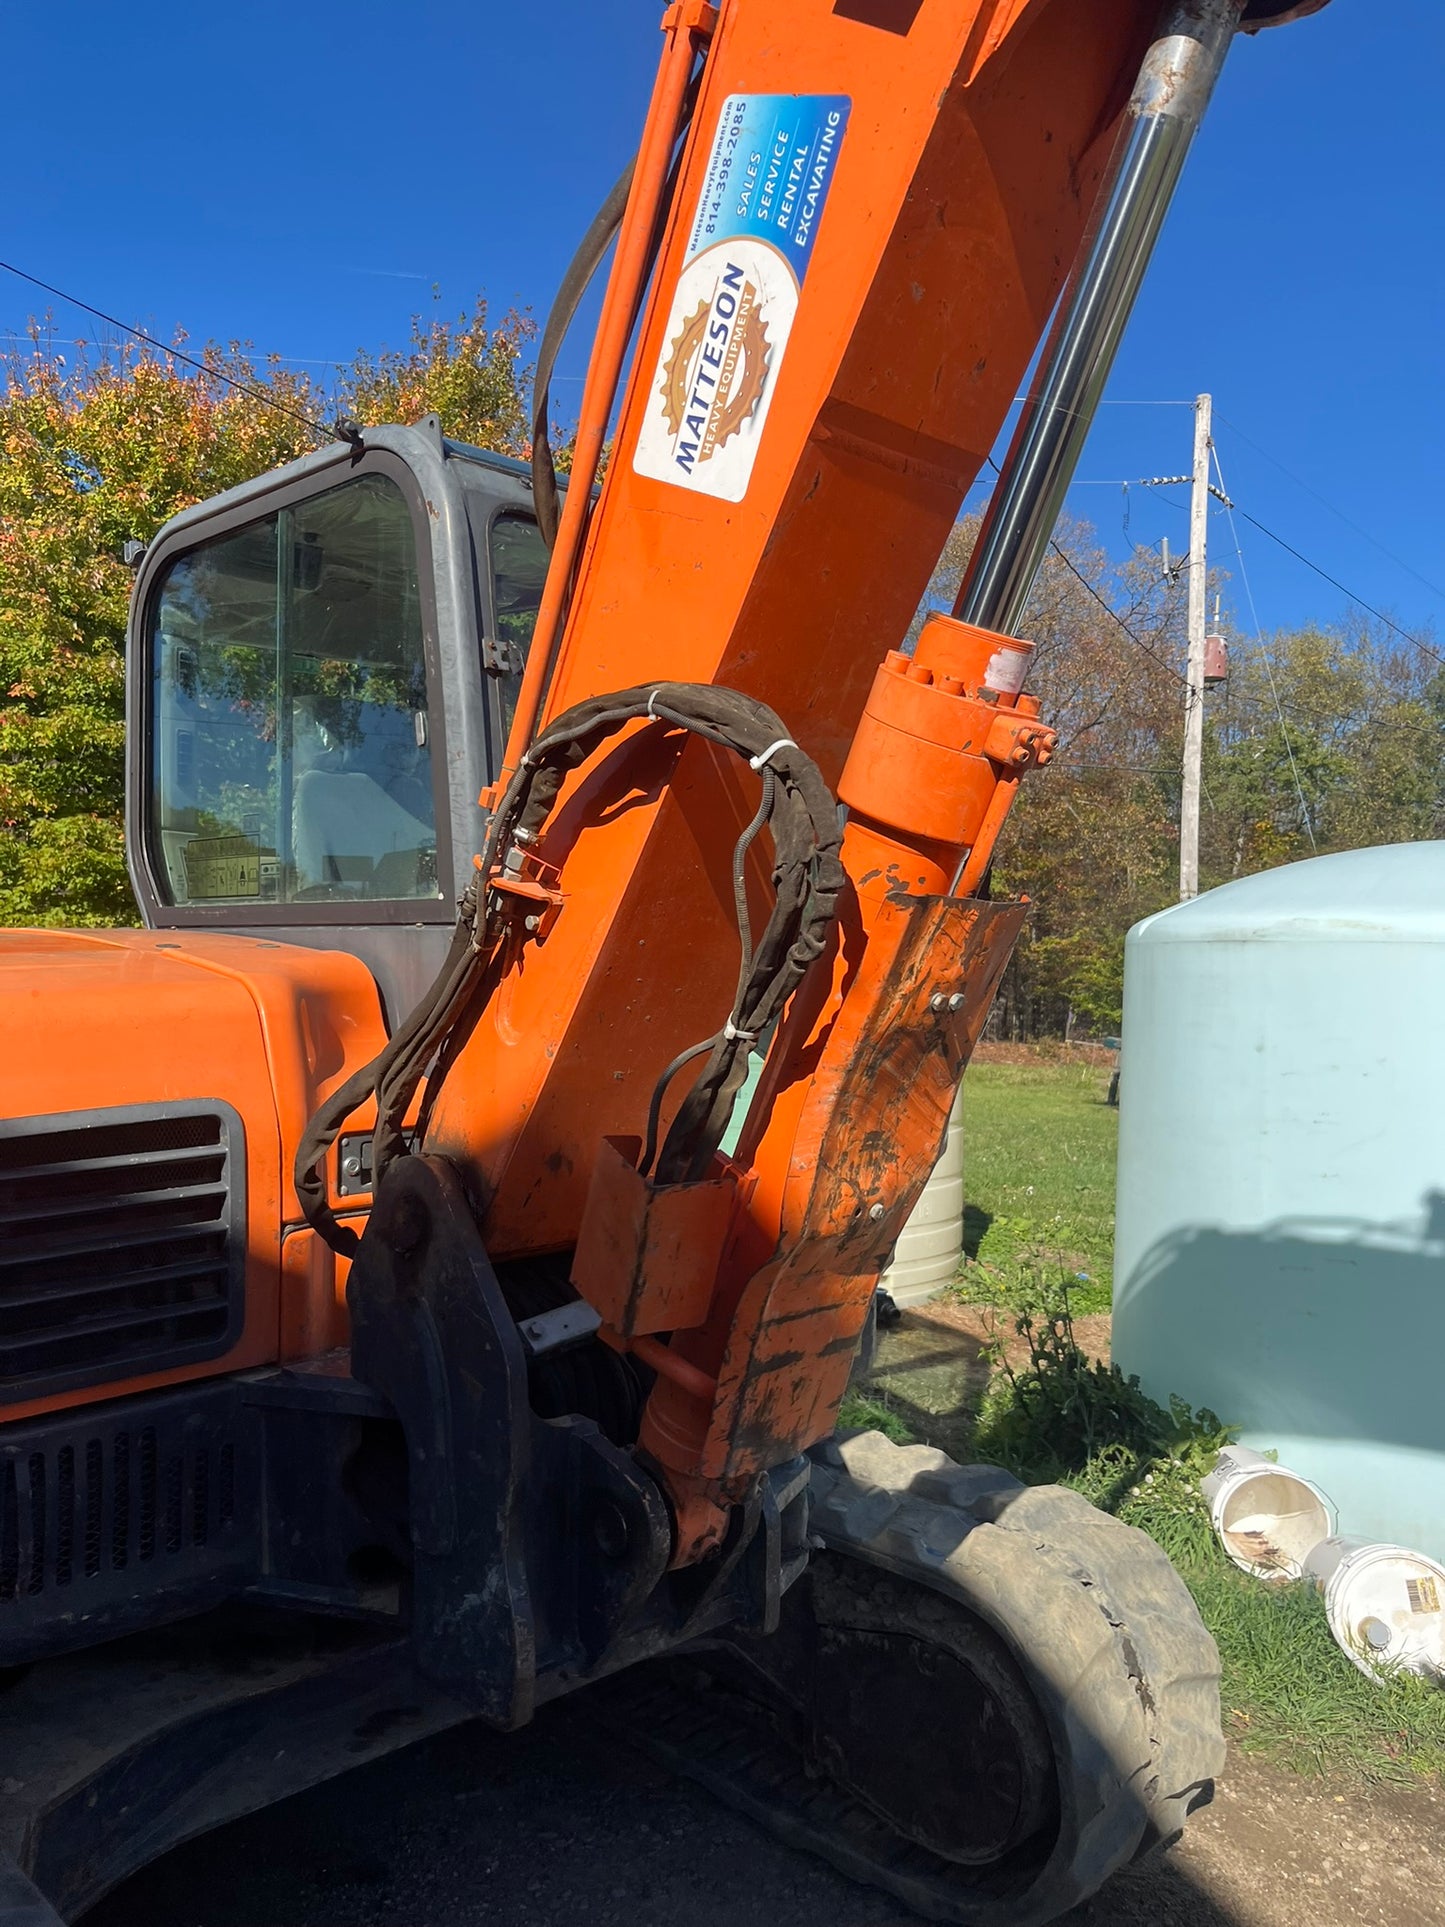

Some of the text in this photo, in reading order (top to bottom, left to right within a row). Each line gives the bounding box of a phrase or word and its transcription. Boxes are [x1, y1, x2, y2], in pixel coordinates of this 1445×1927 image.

[690, 101, 733, 251] MattesonHeavyEquipment.com
[706, 102, 746, 233] 814-398-2085
[736, 151, 761, 217] SALES
[757, 129, 789, 220] SERVICE
[777, 145, 808, 228] RENTAL
[795, 111, 840, 247] EXCAVATING
[675, 262, 745, 475] MATTESON
[703, 293, 753, 455] HEAVY EQUIPMENT
